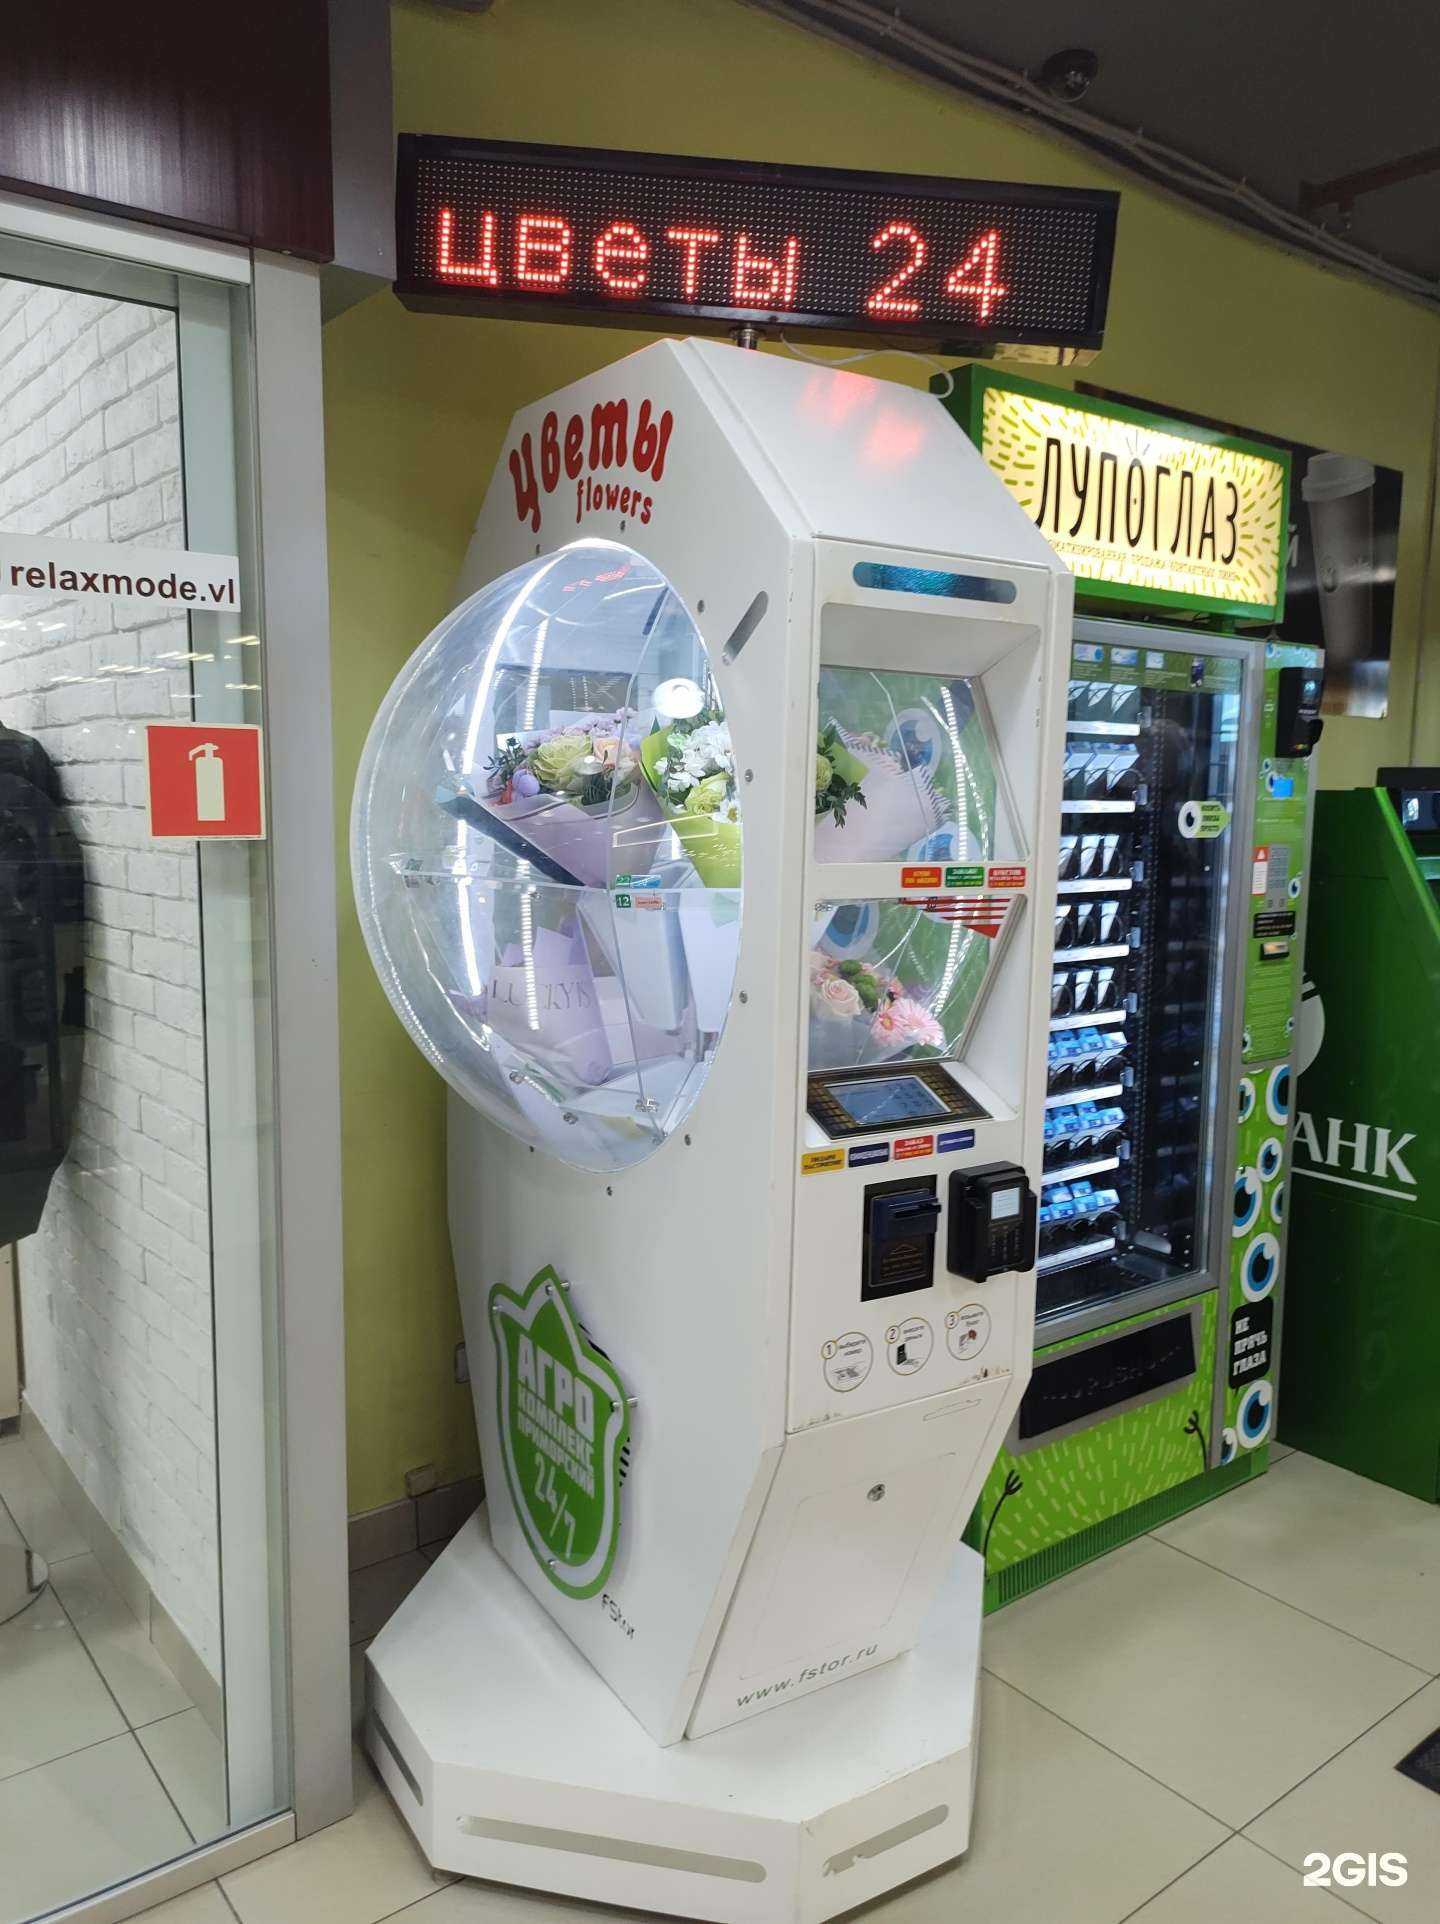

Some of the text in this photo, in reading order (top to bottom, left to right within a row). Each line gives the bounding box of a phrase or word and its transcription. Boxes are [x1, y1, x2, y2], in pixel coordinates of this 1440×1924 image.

[867, 220, 1007, 324] 24
[576, 478, 654, 526] flowers
[1035, 436, 1240, 566] ЛУПОГЛАЗ
[10, 561, 236, 604] relaxmode.vl
[517, 1333, 595, 1444] АГРО
[1233, 1350, 1267, 1376] ГЛАЗА
[534, 1452, 576, 1559] 24/7
[736, 1644, 878, 1707] www.fstor.ru
